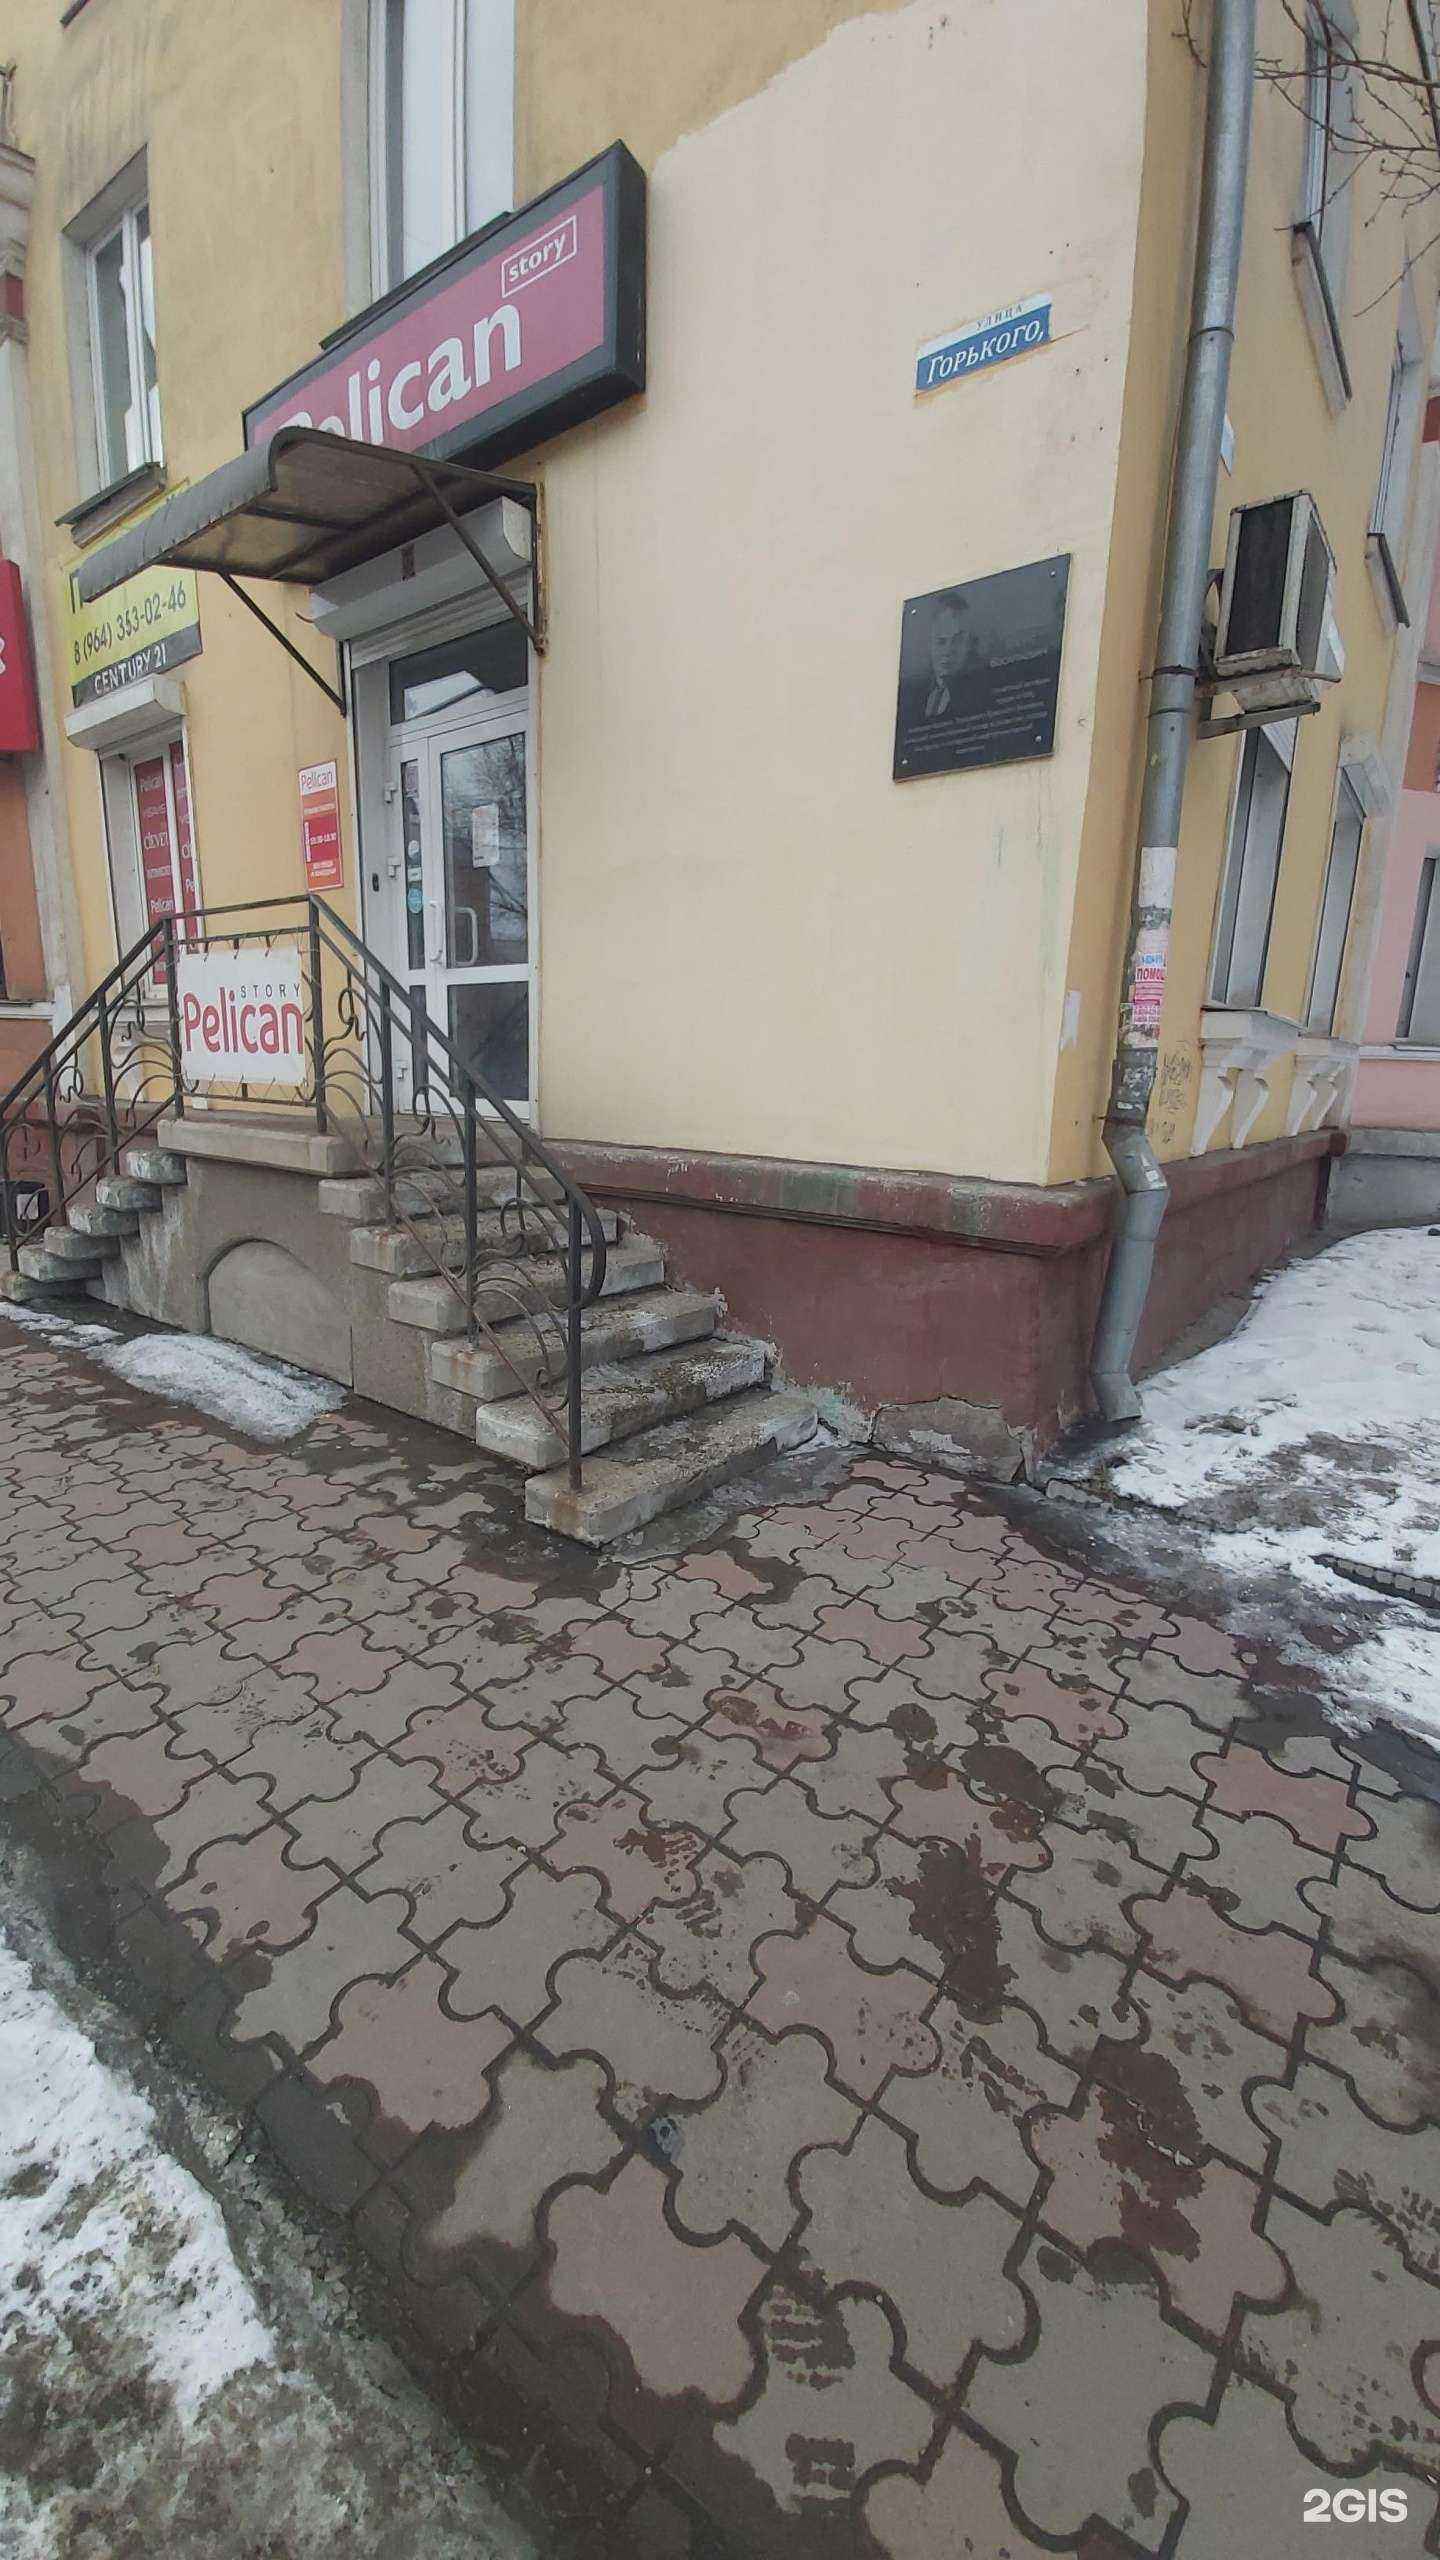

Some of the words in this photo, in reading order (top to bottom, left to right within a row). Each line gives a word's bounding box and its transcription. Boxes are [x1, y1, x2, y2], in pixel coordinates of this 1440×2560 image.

[508, 232, 567, 283] story
[277, 303, 522, 446] lican
[74, 640, 81, 666] 8
[83, 622, 113, 661] (964)
[116, 579, 187, 641] 353-02-46
[94, 648, 151, 695] CENTURY
[154, 642, 167, 668] 21
[301, 770, 333, 789] Pelican
[241, 984, 300, 999] STORY
[183, 986, 304, 1055] Pelican
